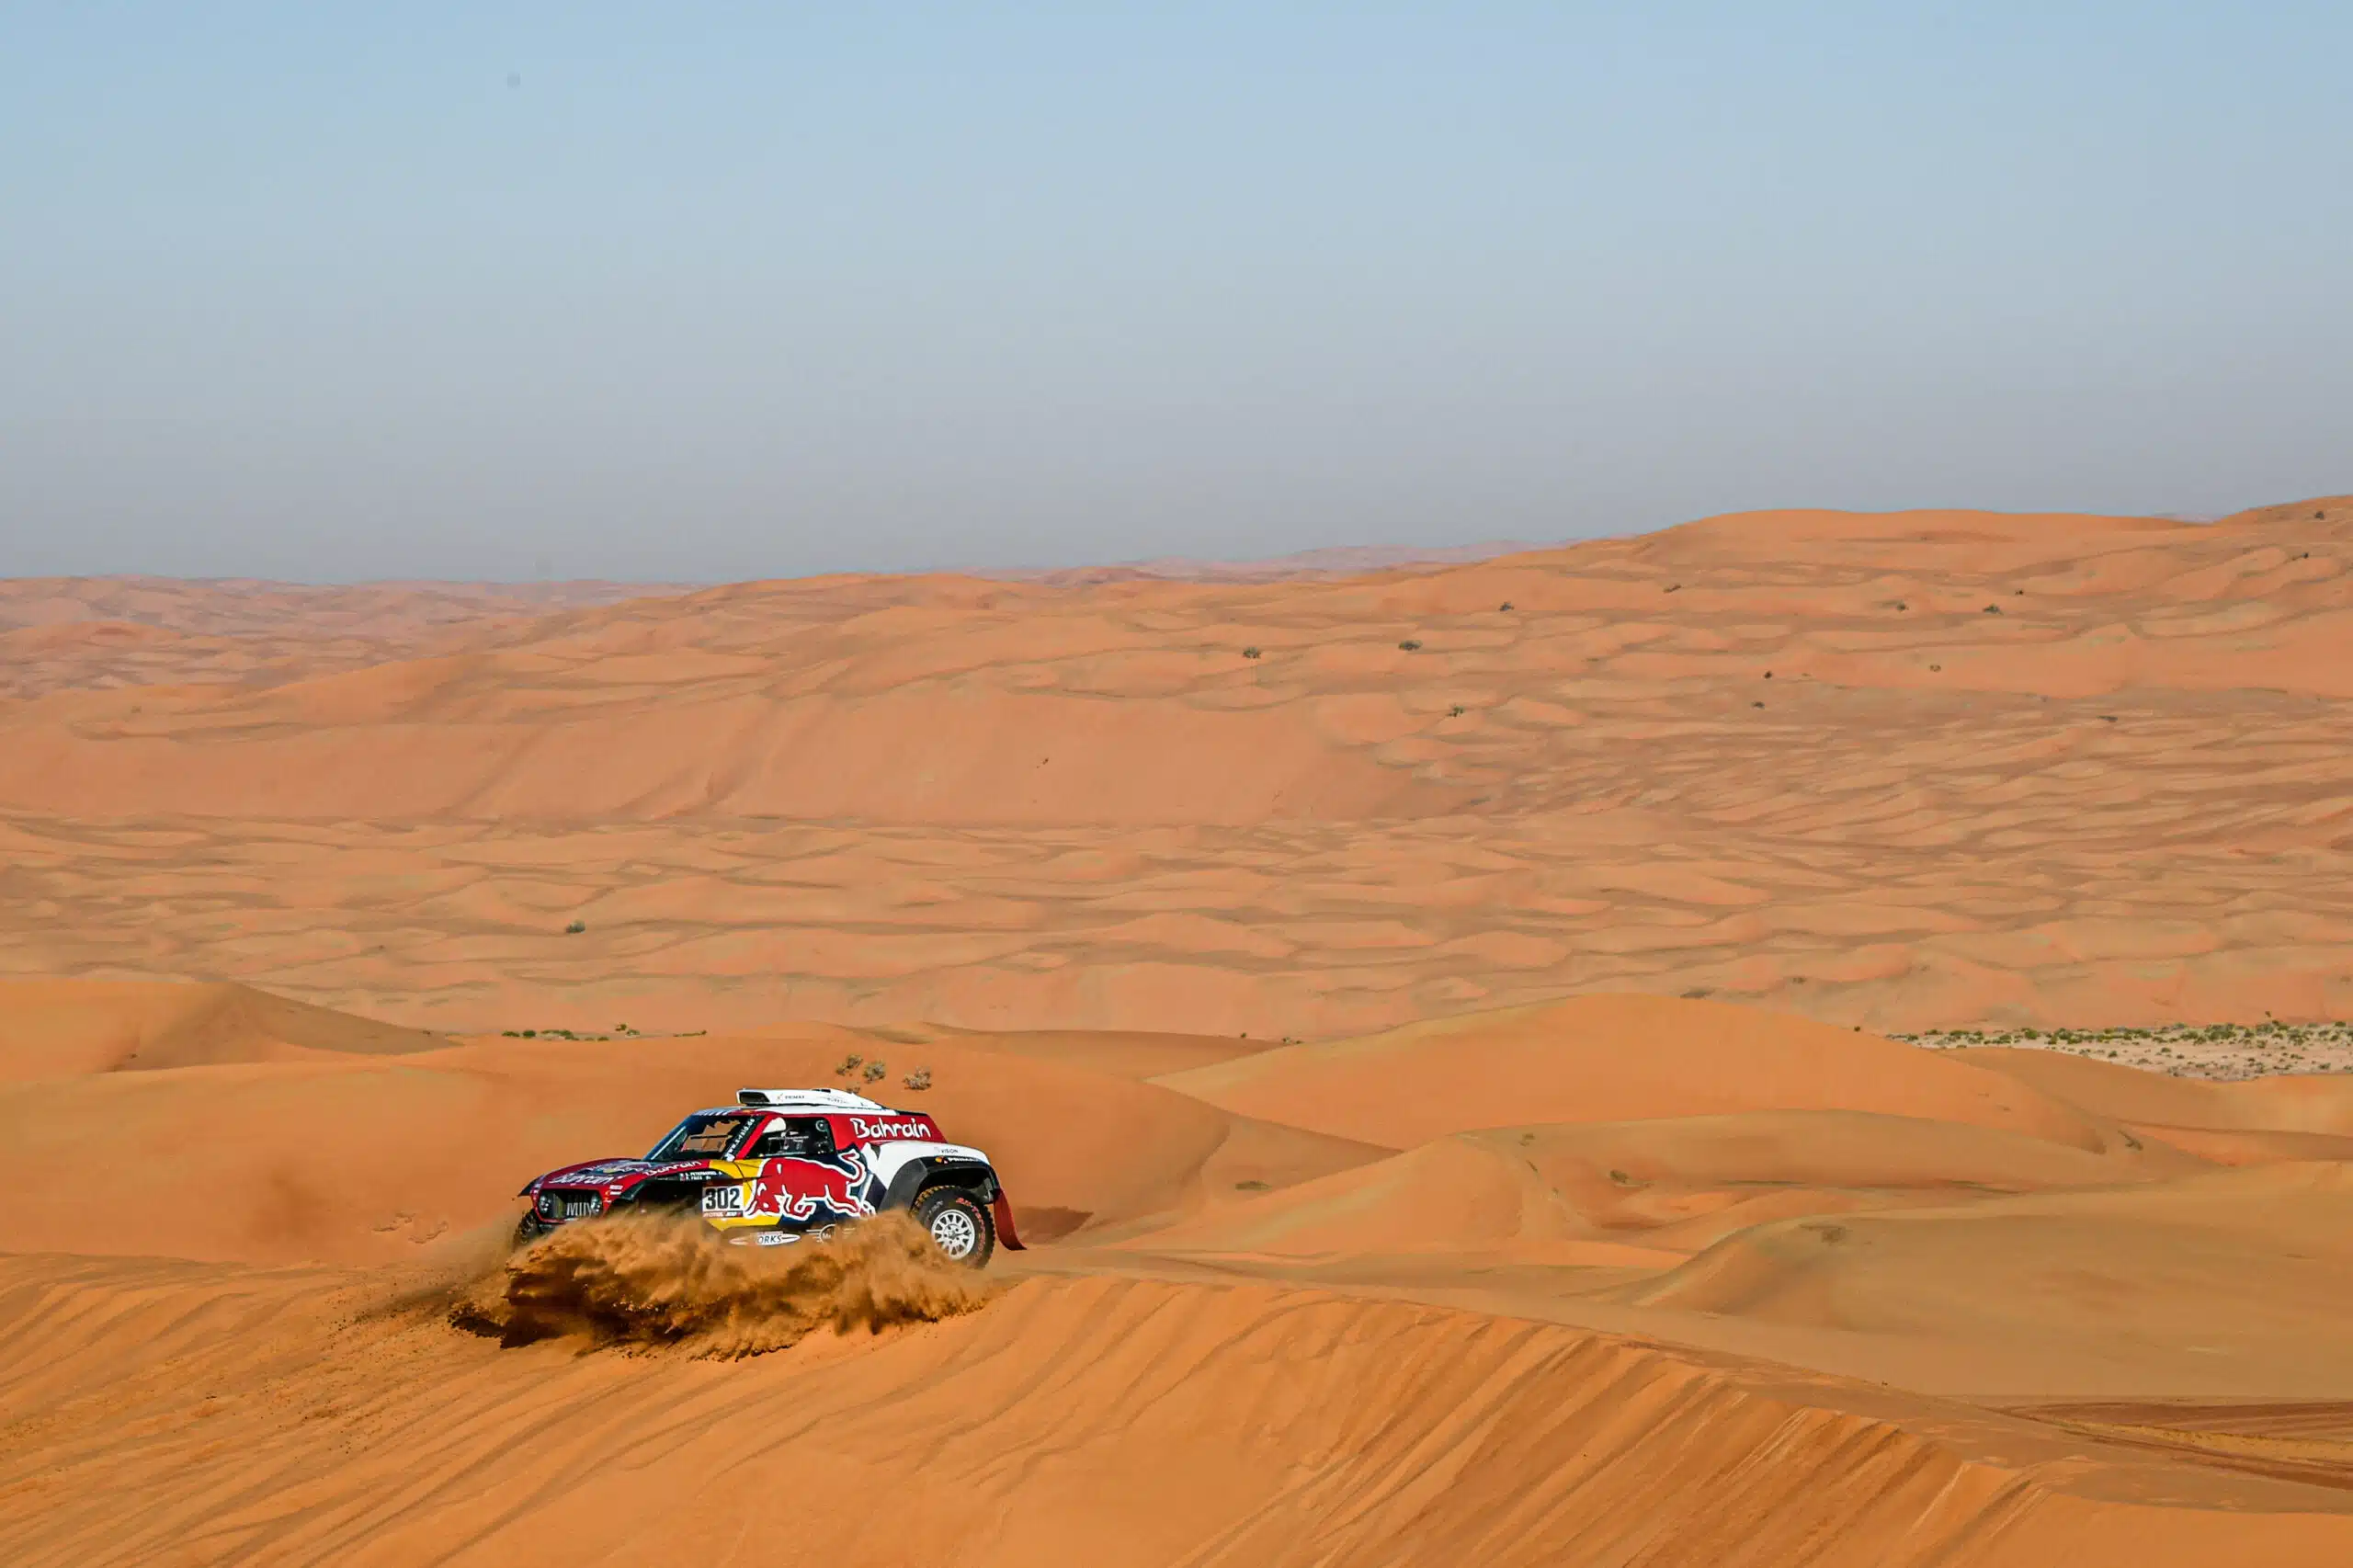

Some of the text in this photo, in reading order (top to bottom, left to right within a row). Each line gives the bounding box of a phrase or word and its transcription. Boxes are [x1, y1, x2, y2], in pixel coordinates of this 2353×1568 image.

[849, 1117, 931, 1139] Bahrain
[643, 1160, 702, 1176] Bahrain
[706, 1187, 741, 1210] 302
